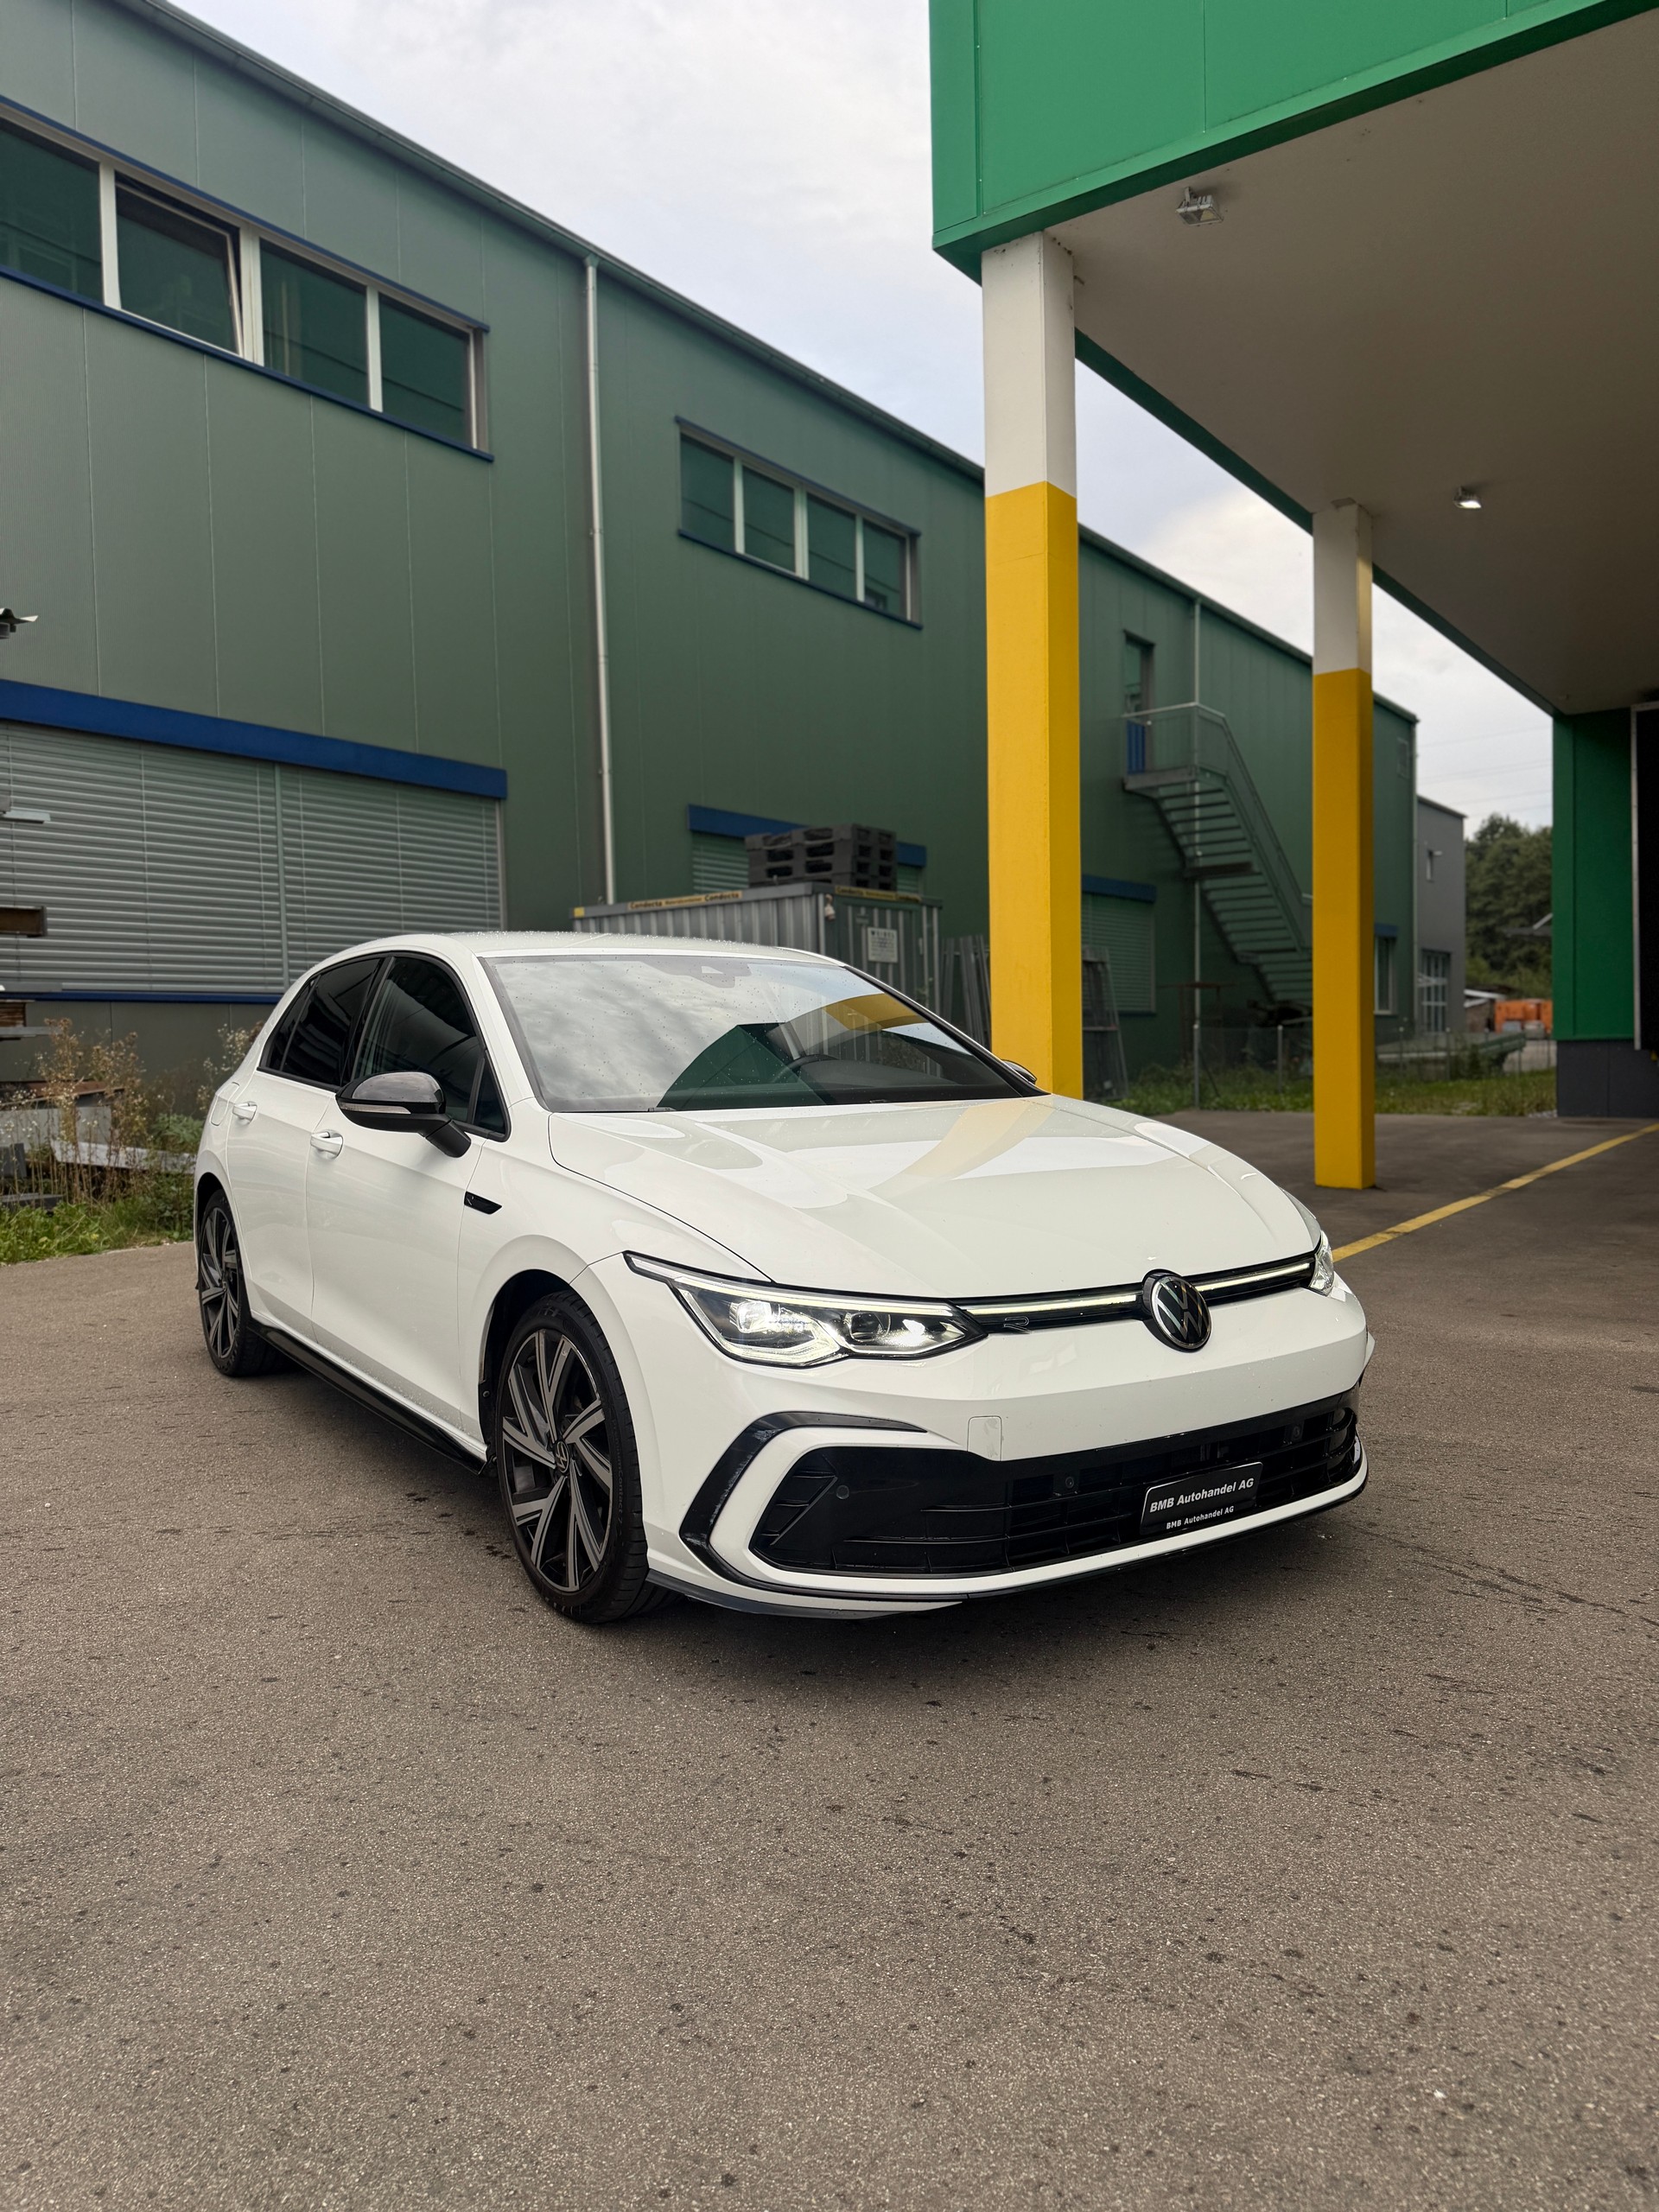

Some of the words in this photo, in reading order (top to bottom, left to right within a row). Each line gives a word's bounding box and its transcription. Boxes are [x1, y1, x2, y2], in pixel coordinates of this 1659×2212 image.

[1149, 1497, 1174, 1513] BMB
[1176, 1482, 1236, 1506] Autohandel
[1238, 1478, 1255, 1491] AG
[1166, 1519, 1182, 1529] BMB
[1184, 1509, 1224, 1525] Autohandel
[1224, 1505, 1234, 1514] AG
